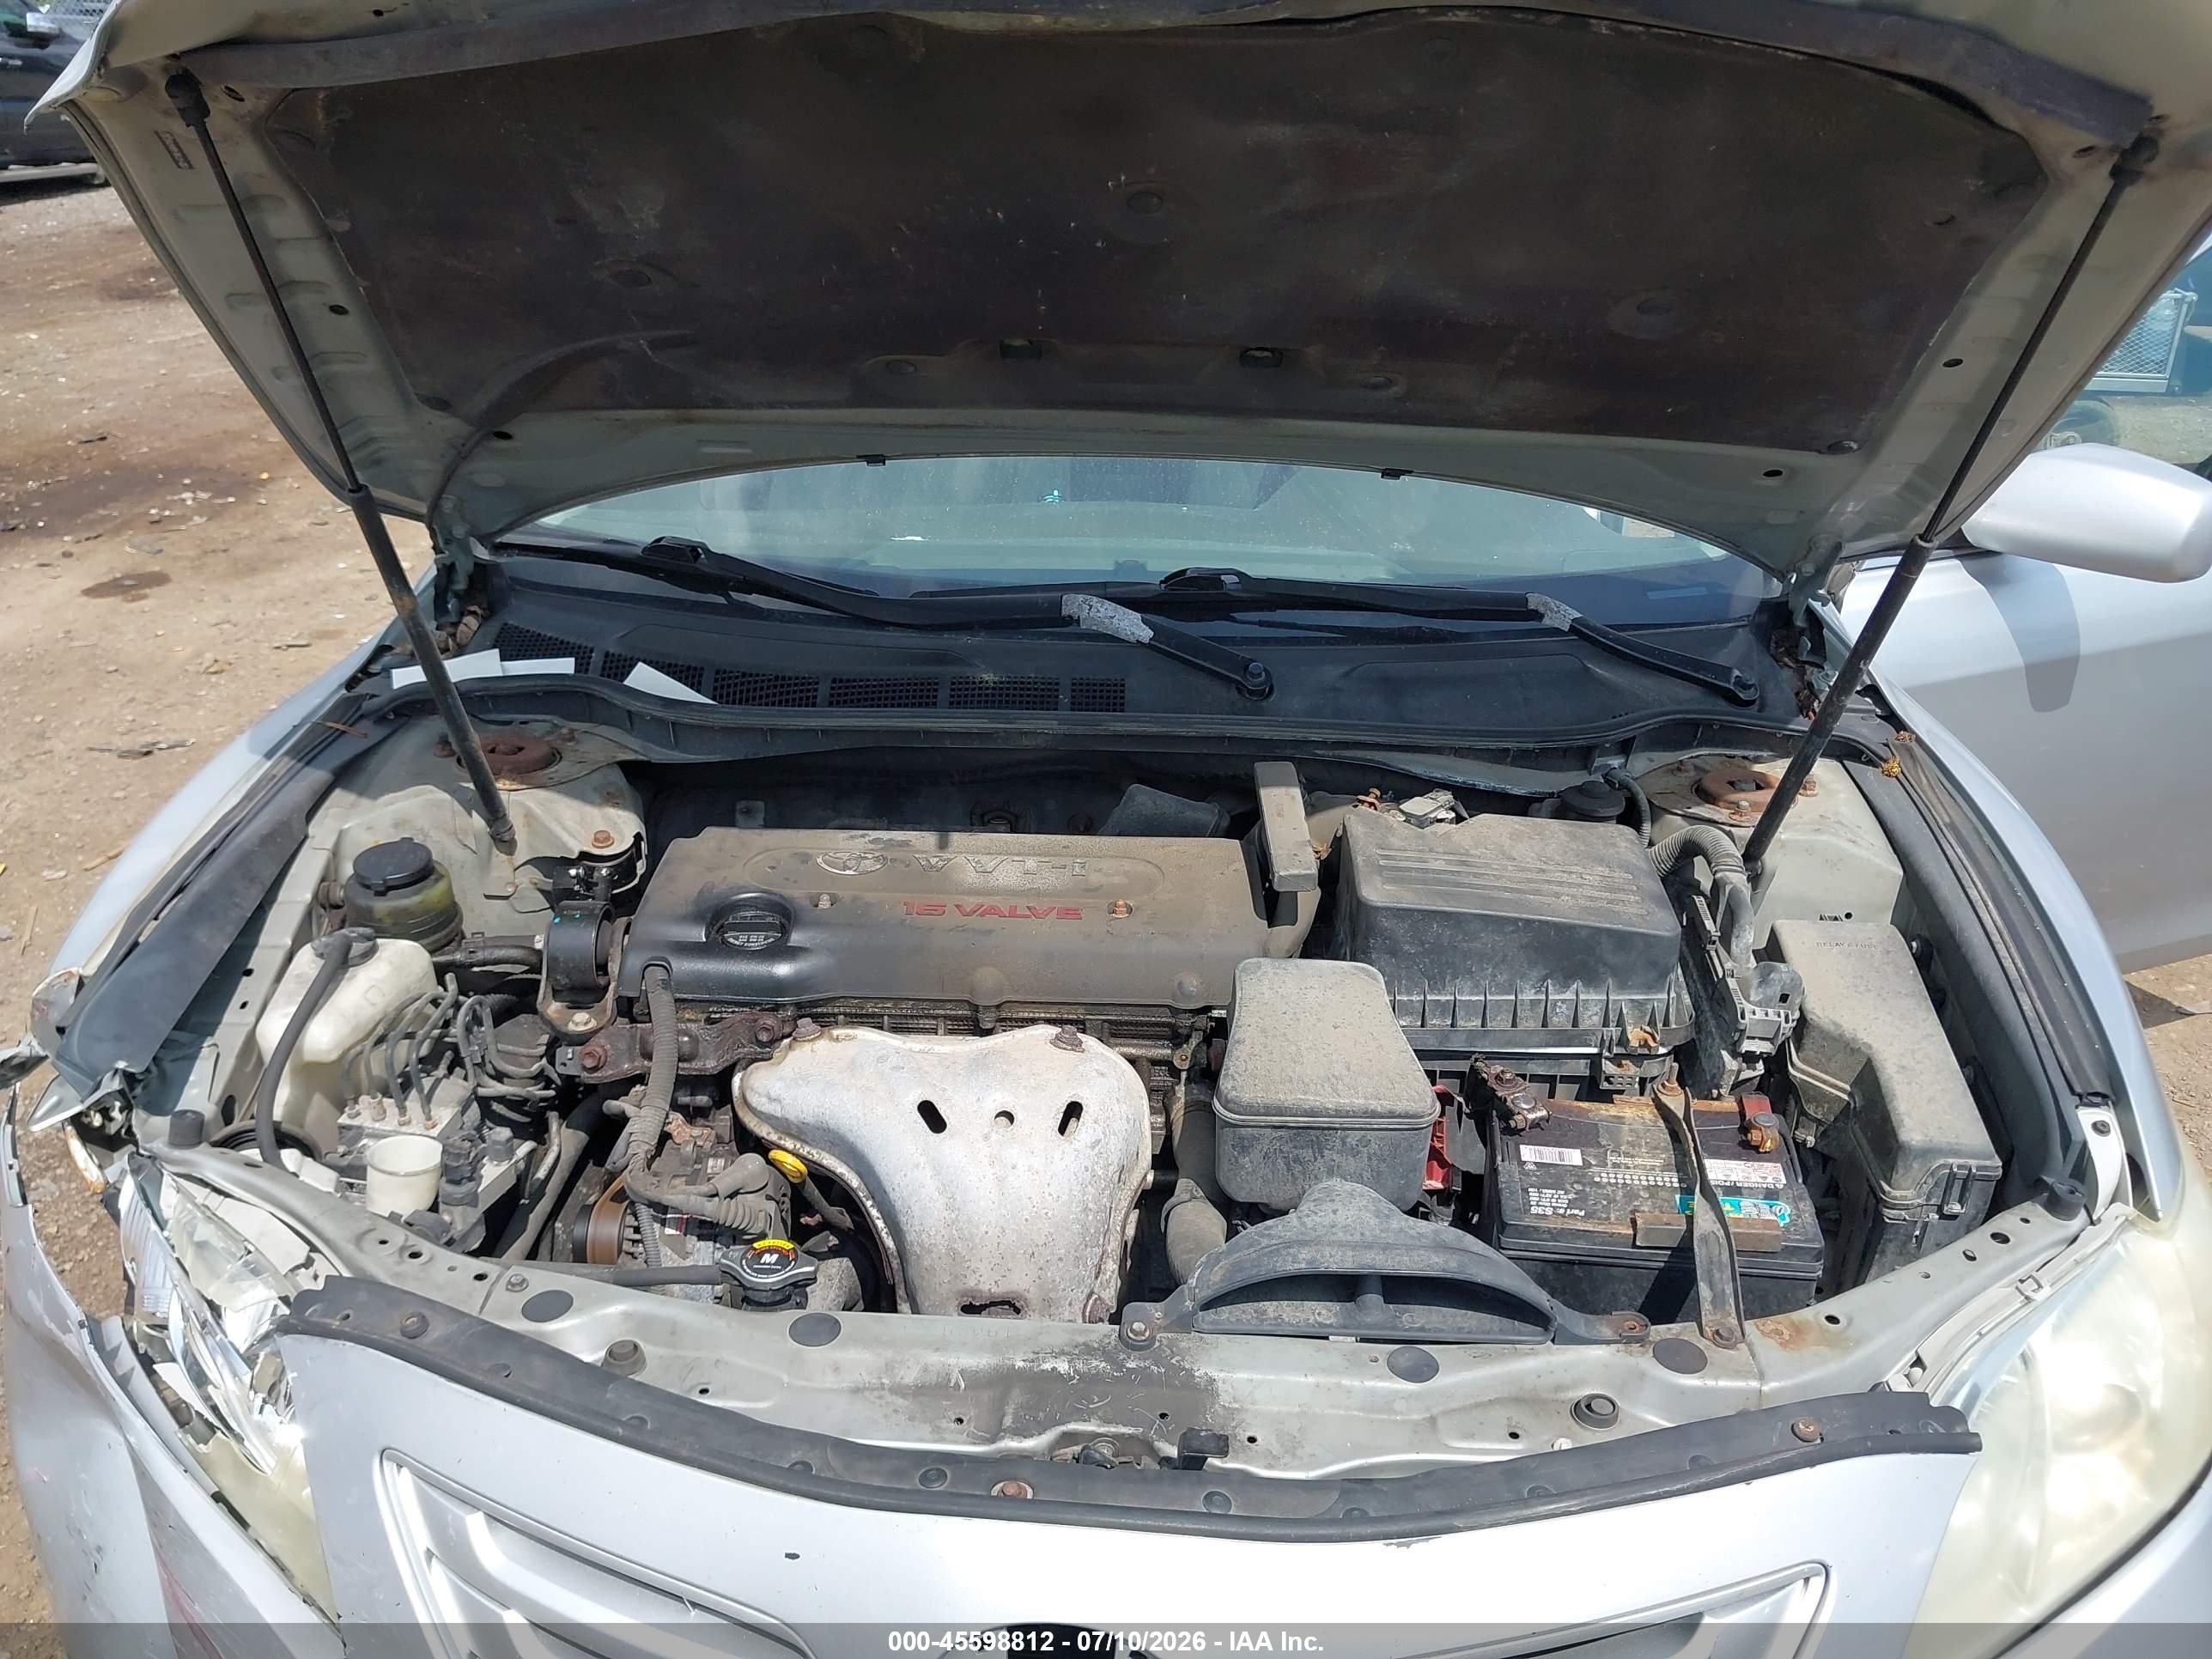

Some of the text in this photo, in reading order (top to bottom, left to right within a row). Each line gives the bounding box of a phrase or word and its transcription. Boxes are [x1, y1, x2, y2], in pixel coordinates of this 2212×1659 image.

[904, 902, 1084, 920] 16 VALVE
[1529, 1206, 1553, 1216] S35
[1566, 1208, 1585, 1217] Part
